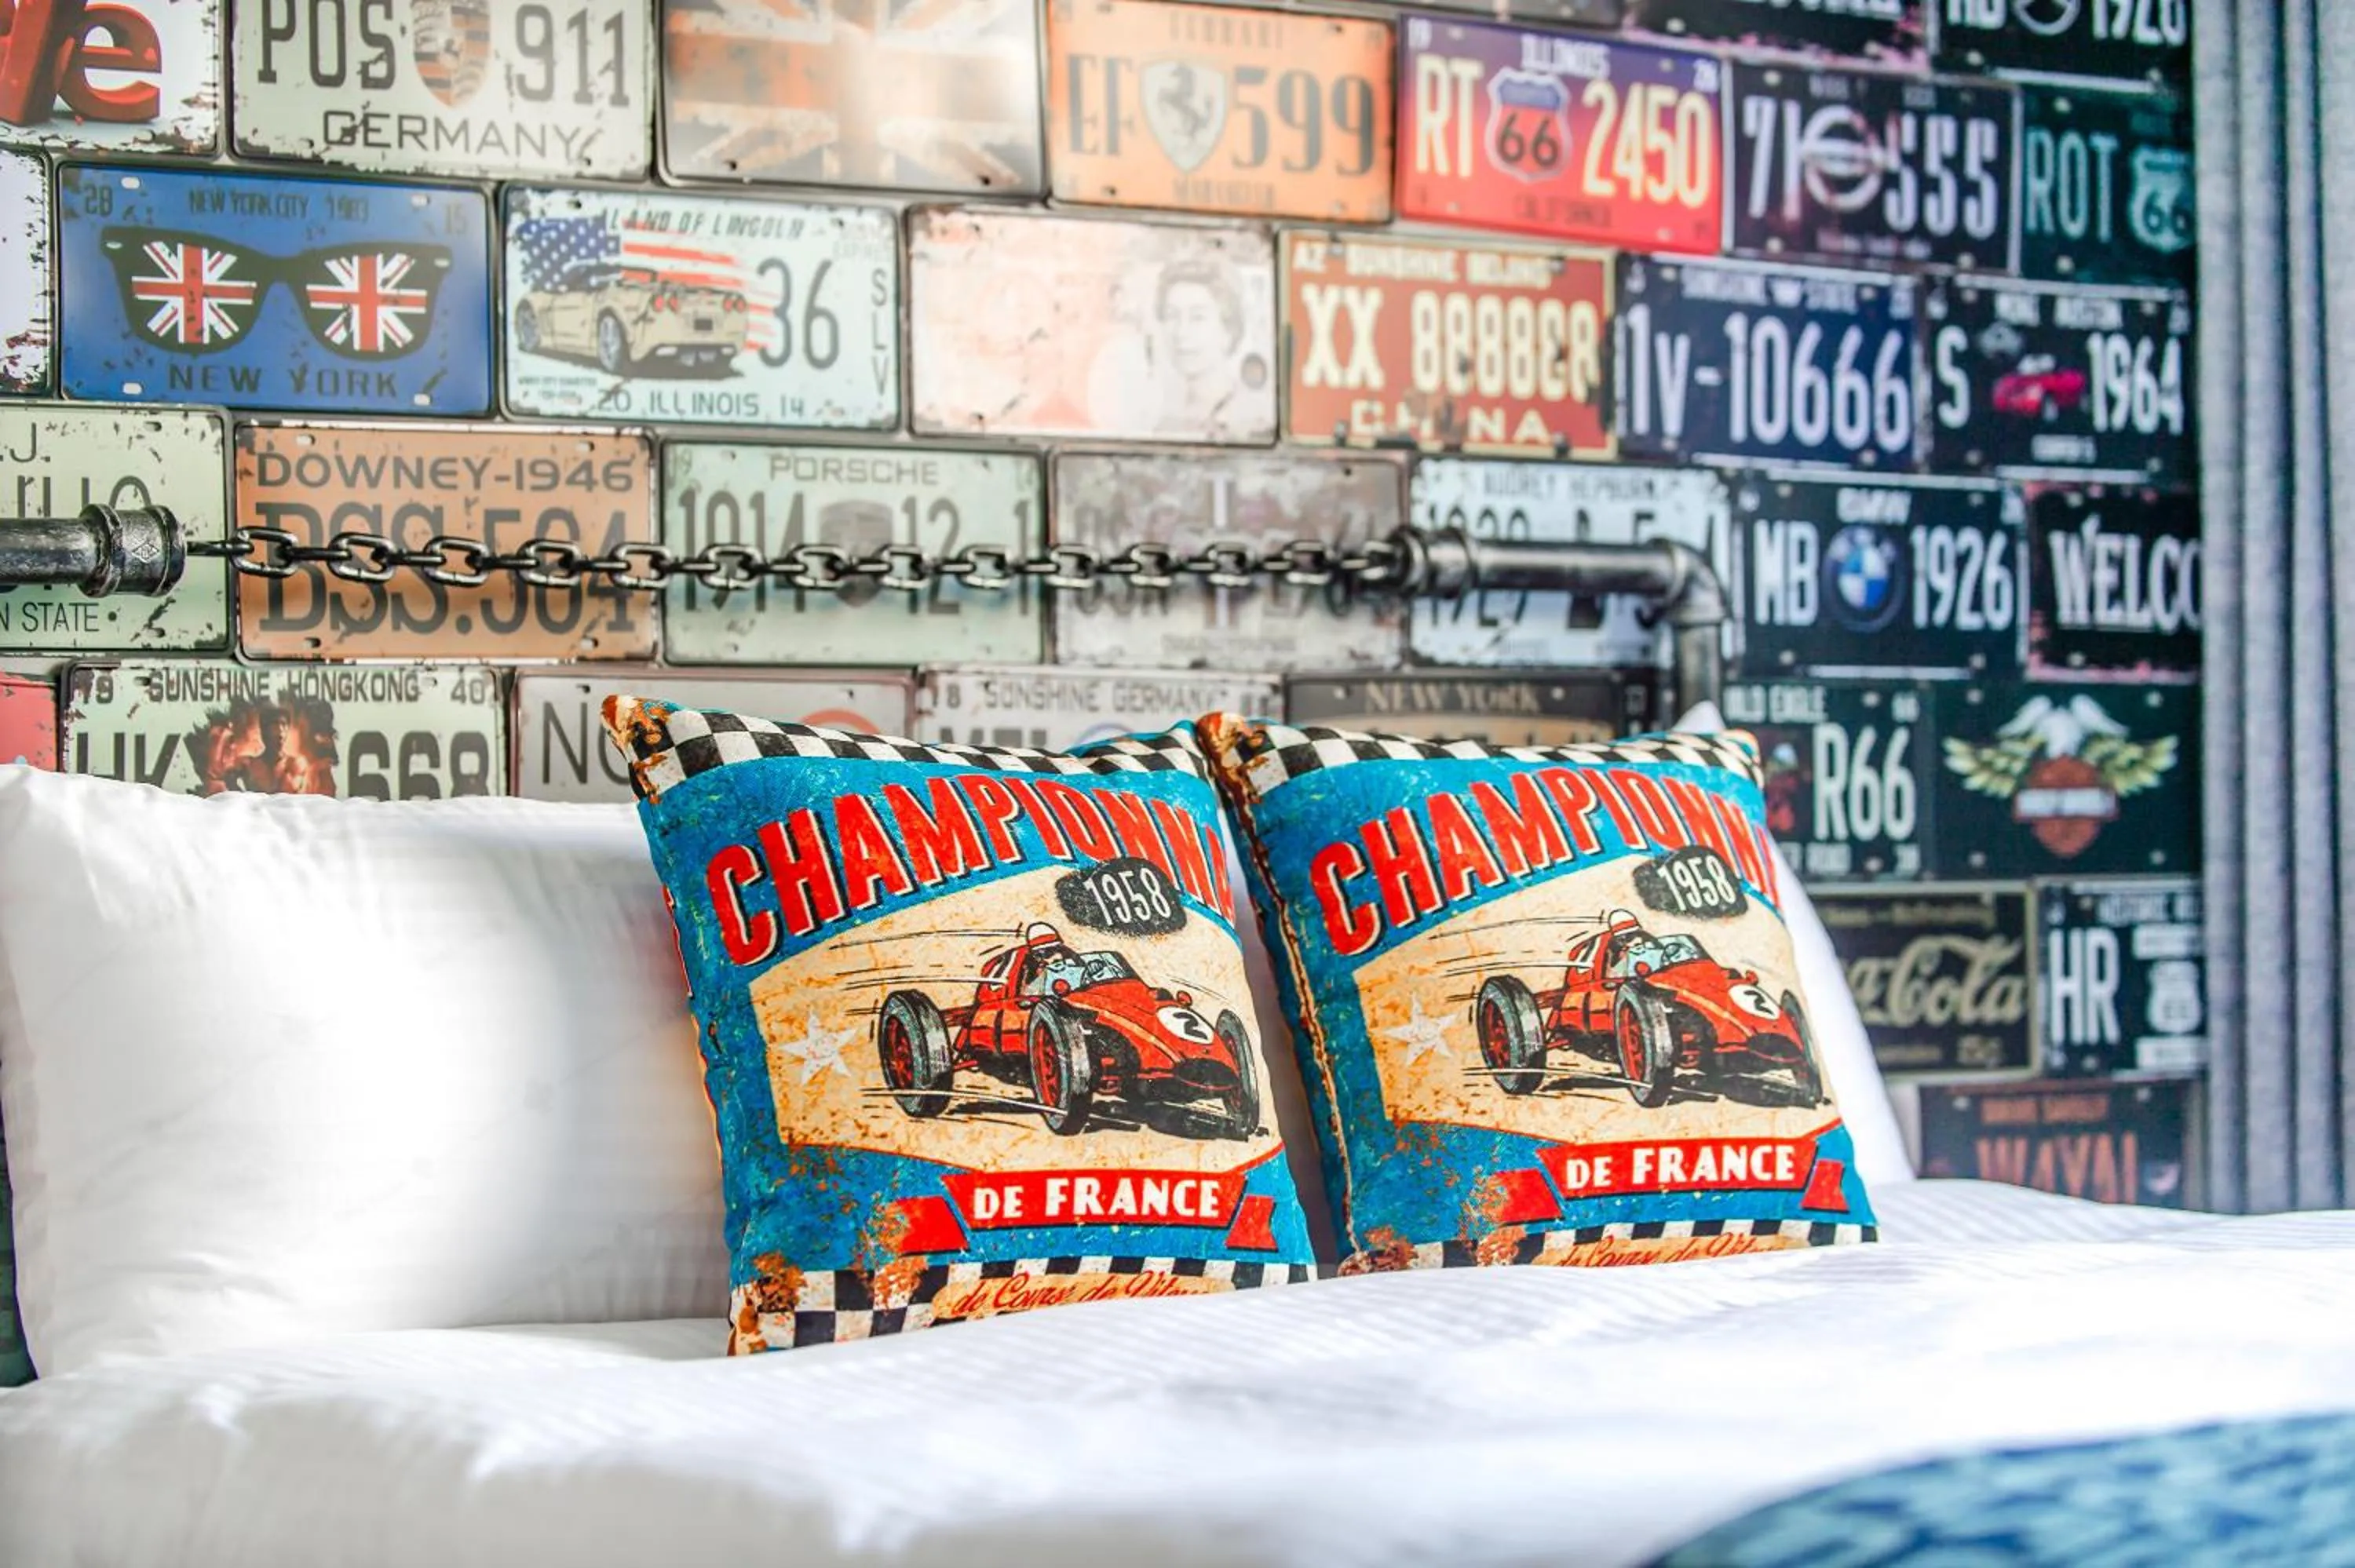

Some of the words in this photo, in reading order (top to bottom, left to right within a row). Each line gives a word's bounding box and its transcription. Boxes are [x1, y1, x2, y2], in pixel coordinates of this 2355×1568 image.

[515, 4, 629, 108] 911
[323, 109, 582, 159] GERMANY
[1232, 66, 1375, 176] 599
[1416, 53, 1484, 179] RT
[1498, 112, 1560, 168] 66
[1582, 79, 1713, 209] 2450
[188, 188, 225, 214] NEW
[2027, 127, 2120, 243] ROT
[609, 206, 670, 233] LAND
[677, 211, 703, 236] OF
[757, 257, 839, 370] 36
[1301, 282, 1386, 389] XX
[170, 363, 261, 394] NEW
[289, 364, 399, 399] YORK
[1936, 324, 1971, 428] S
[2085, 330, 2185, 436] 1964
[649, 392, 760, 418] ILLINOIS
[780, 396, 805, 418] 14
[256, 451, 634, 493] DOWNEY-1946
[769, 454, 941, 485] PORSCHE
[1910, 524, 2014, 632] 1926
[22, 602, 100, 633] STATE
[148, 671, 270, 702] SUNSHINE
[288, 673, 420, 703] HONGKONG
[451, 678, 486, 704] 40
[1366, 680, 1449, 713] NEW
[1456, 680, 1542, 715] YORK
[1813, 721, 1916, 841] R66
[1083, 865, 1172, 928] 1958
[1656, 854, 1736, 912] 1958
[1743, 990, 1775, 1016] 2
[2049, 926, 2119, 1045] HR
[1173, 1012, 1208, 1041] 2
[1566, 1155, 1613, 1190] DE
[1631, 1144, 1795, 1185] FRANCE
[973, 1185, 1024, 1220] DE
[1045, 1176, 1219, 1218] FRANCE
